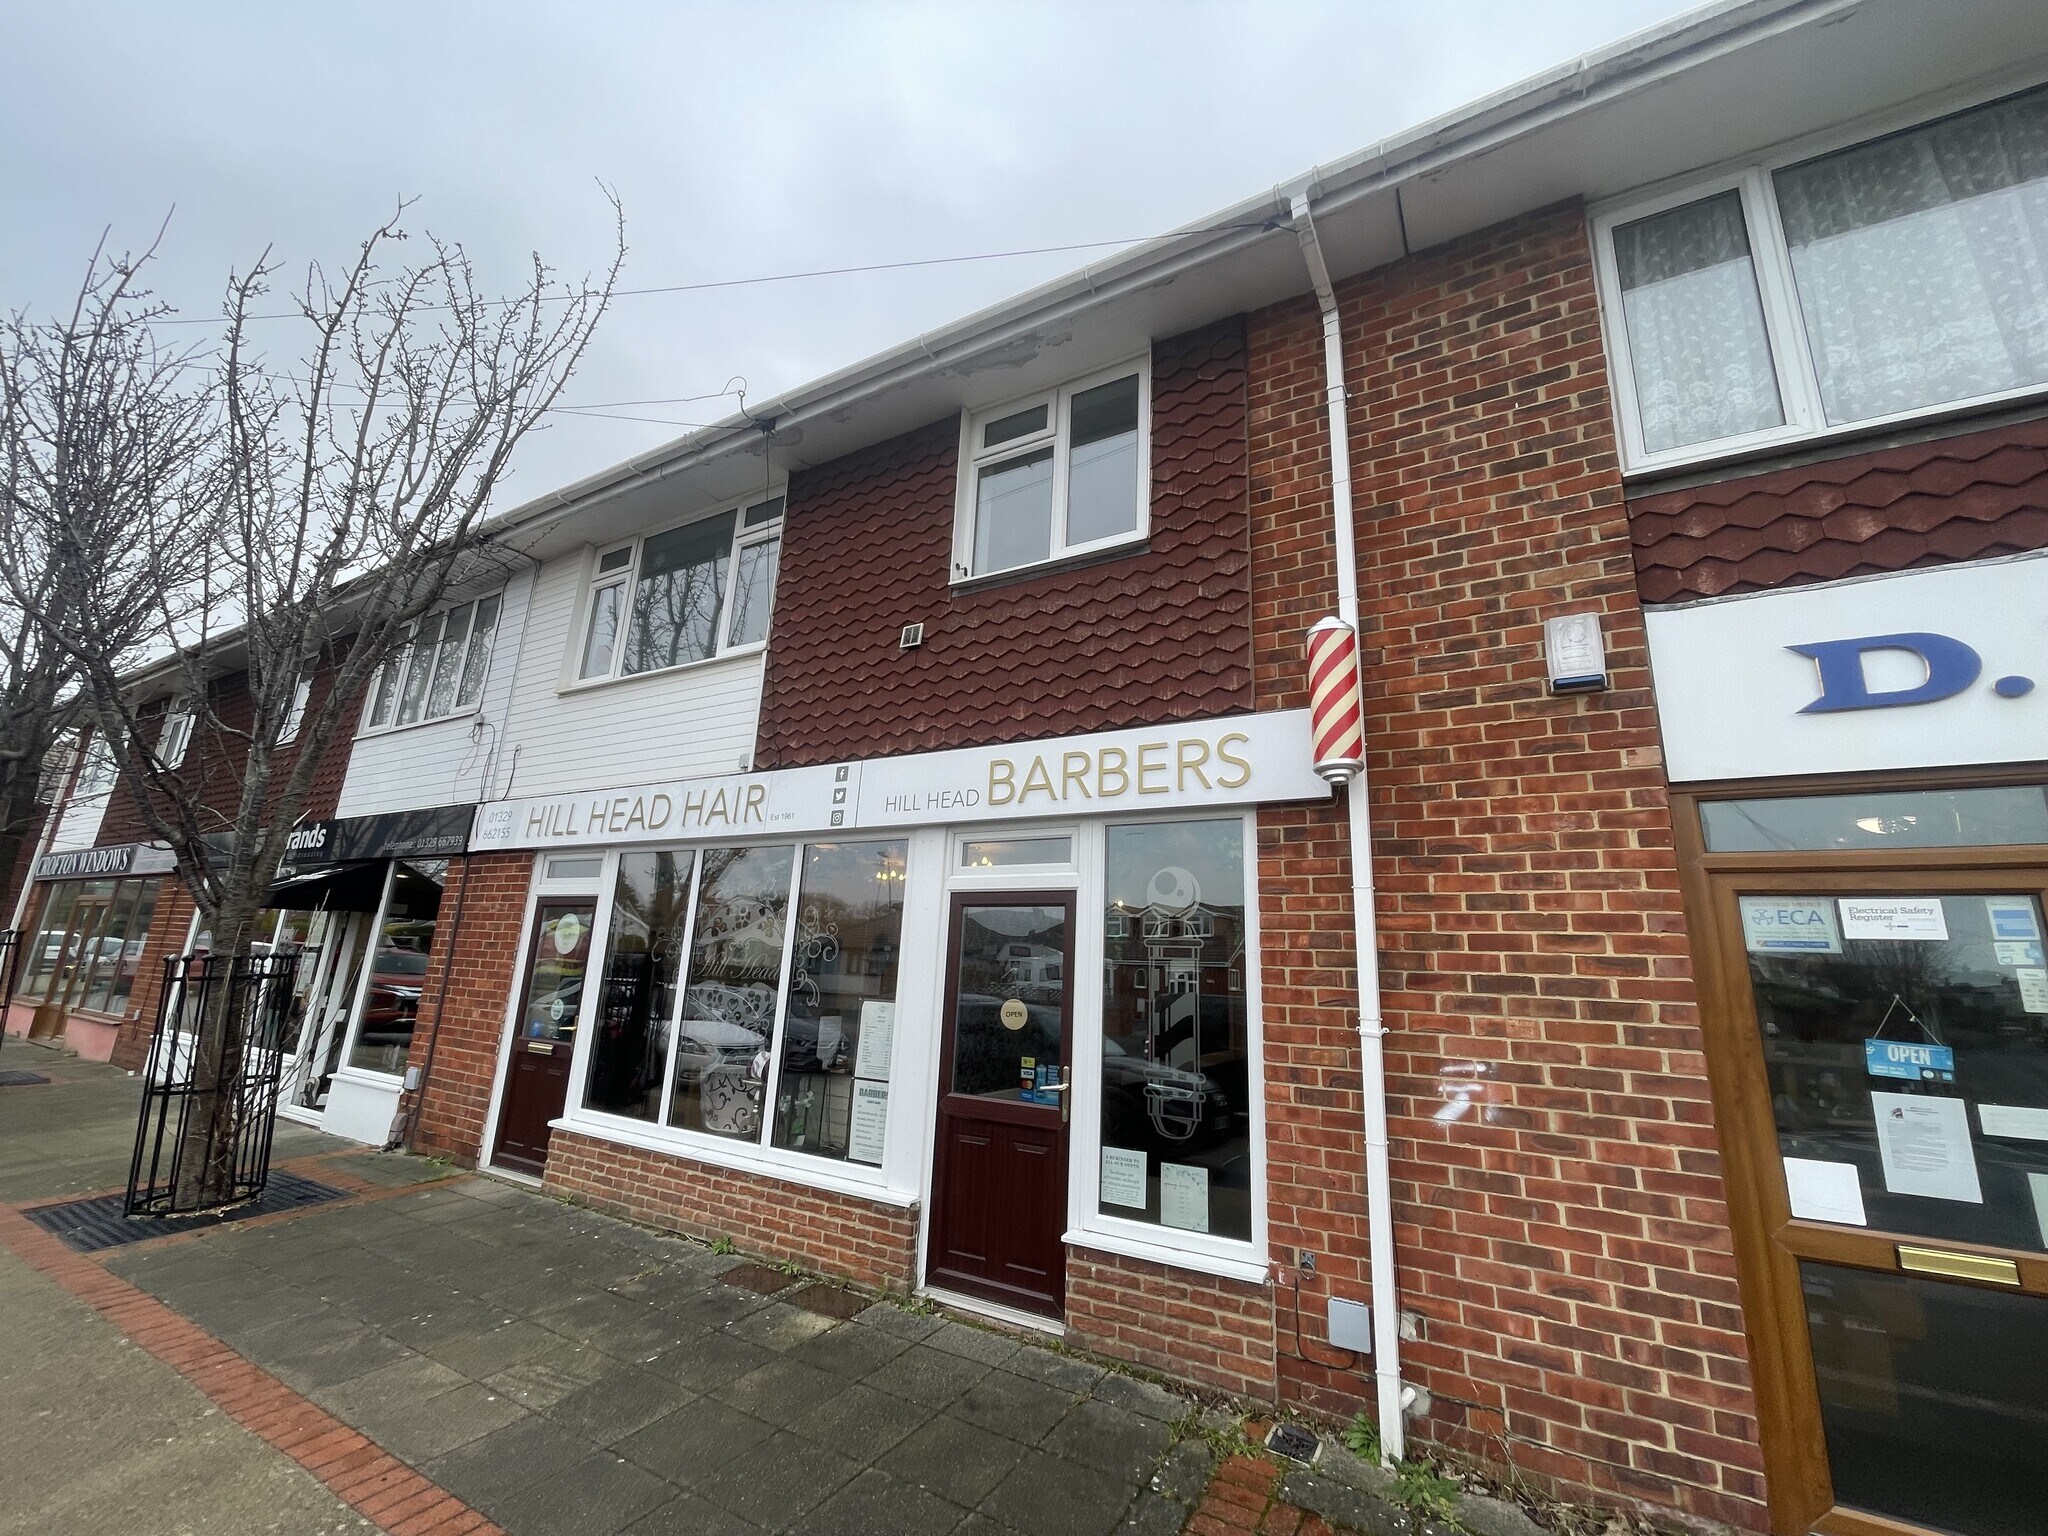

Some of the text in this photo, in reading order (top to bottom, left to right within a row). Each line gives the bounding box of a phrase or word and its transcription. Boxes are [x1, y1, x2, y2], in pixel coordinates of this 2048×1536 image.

[1784, 632, 2036, 714] D.
[885, 732, 1251, 813] HILL HEAD BARBERS
[489, 810, 512, 823] 01329
[525, 784, 766, 838] HILL HEAD HAIR
[770, 812, 795, 821] Est 1961
[286, 823, 327, 849] rands
[482, 827, 511, 840] 662155
[36, 848, 130, 876] CROFTON WINDOWS
[1777, 910, 1825, 925] ECA
[1848, 907, 1934, 917] Electrical Safety
[1850, 914, 1894, 922] Register
[692, 953, 731, 978] Hill
[1887, 1045, 1932, 1066] OPEN
